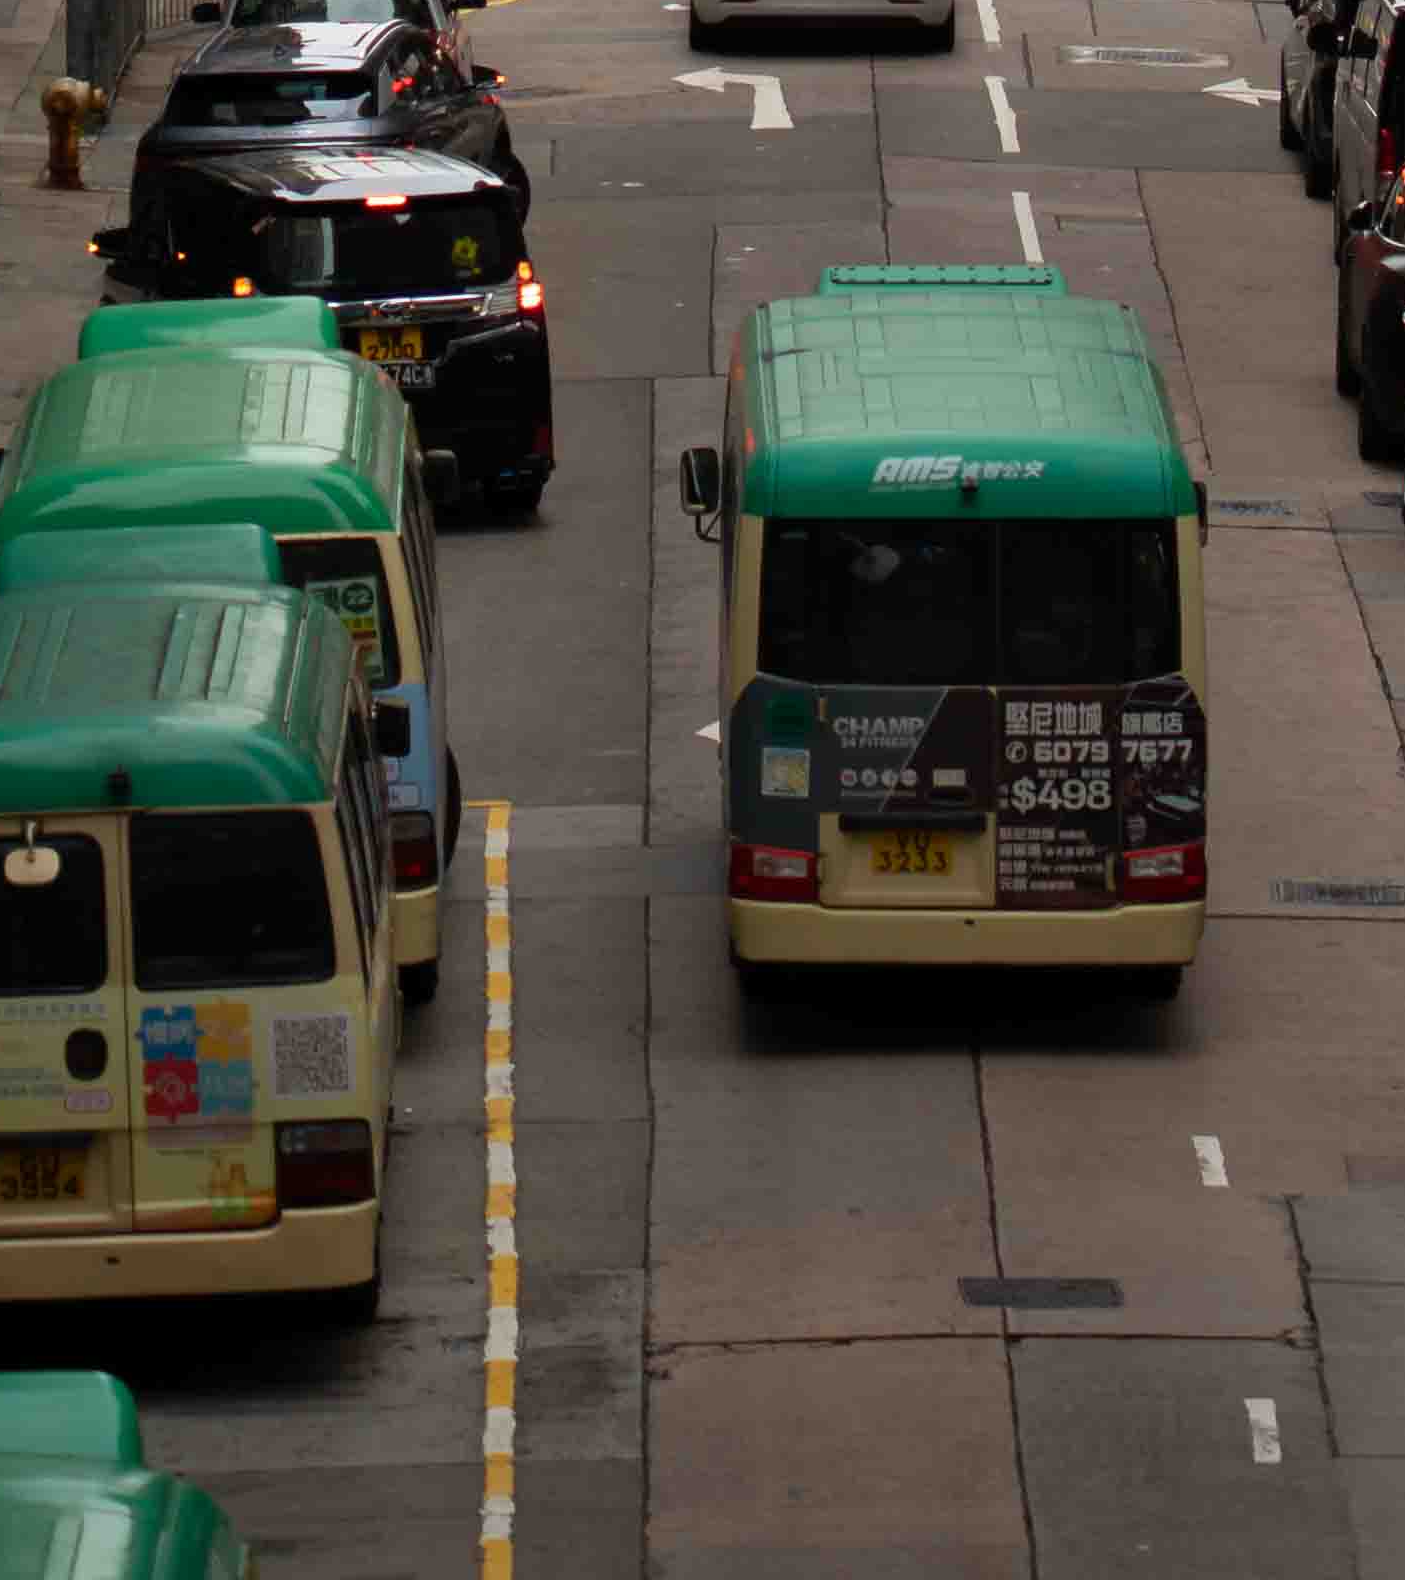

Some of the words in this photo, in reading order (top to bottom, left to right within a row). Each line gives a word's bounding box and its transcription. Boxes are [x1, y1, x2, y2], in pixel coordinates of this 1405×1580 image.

[873, 455, 963, 483] AMS
[347, 588, 372, 604] 22
[835, 715, 925, 734] CHAMP
[1004, 701, 1102, 736] 堅尼地城
[1033, 739, 1110, 763] 6079
[1121, 739, 1193, 763] 7677
[1010, 776, 1112, 815] $498
